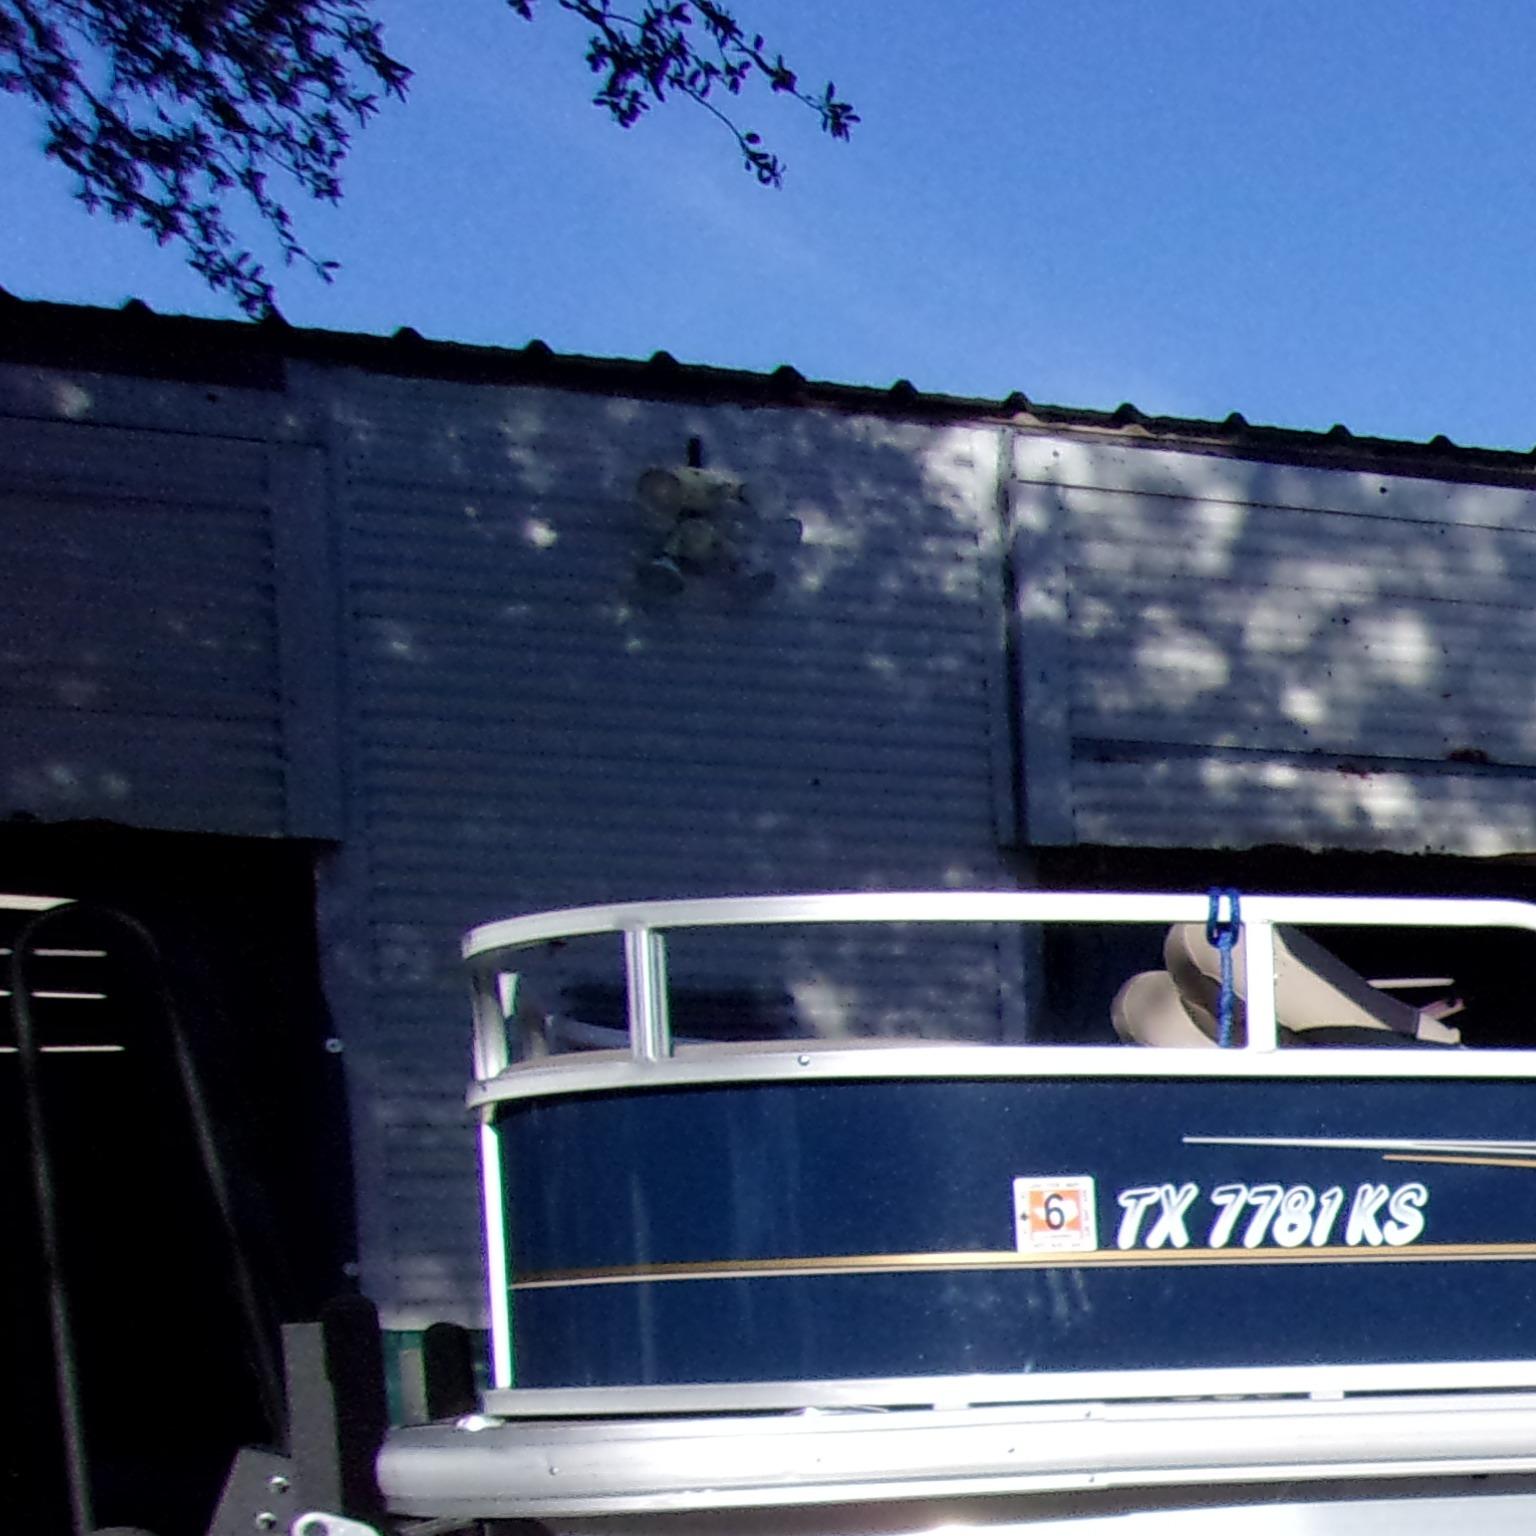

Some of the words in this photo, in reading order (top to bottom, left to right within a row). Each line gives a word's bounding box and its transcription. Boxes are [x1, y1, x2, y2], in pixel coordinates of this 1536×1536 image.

[1043, 1192, 1065, 1230] 6
[1117, 1183, 1199, 1250] TX
[1209, 1183, 1344, 1249] 7781
[1346, 1182, 1428, 1247] KS
